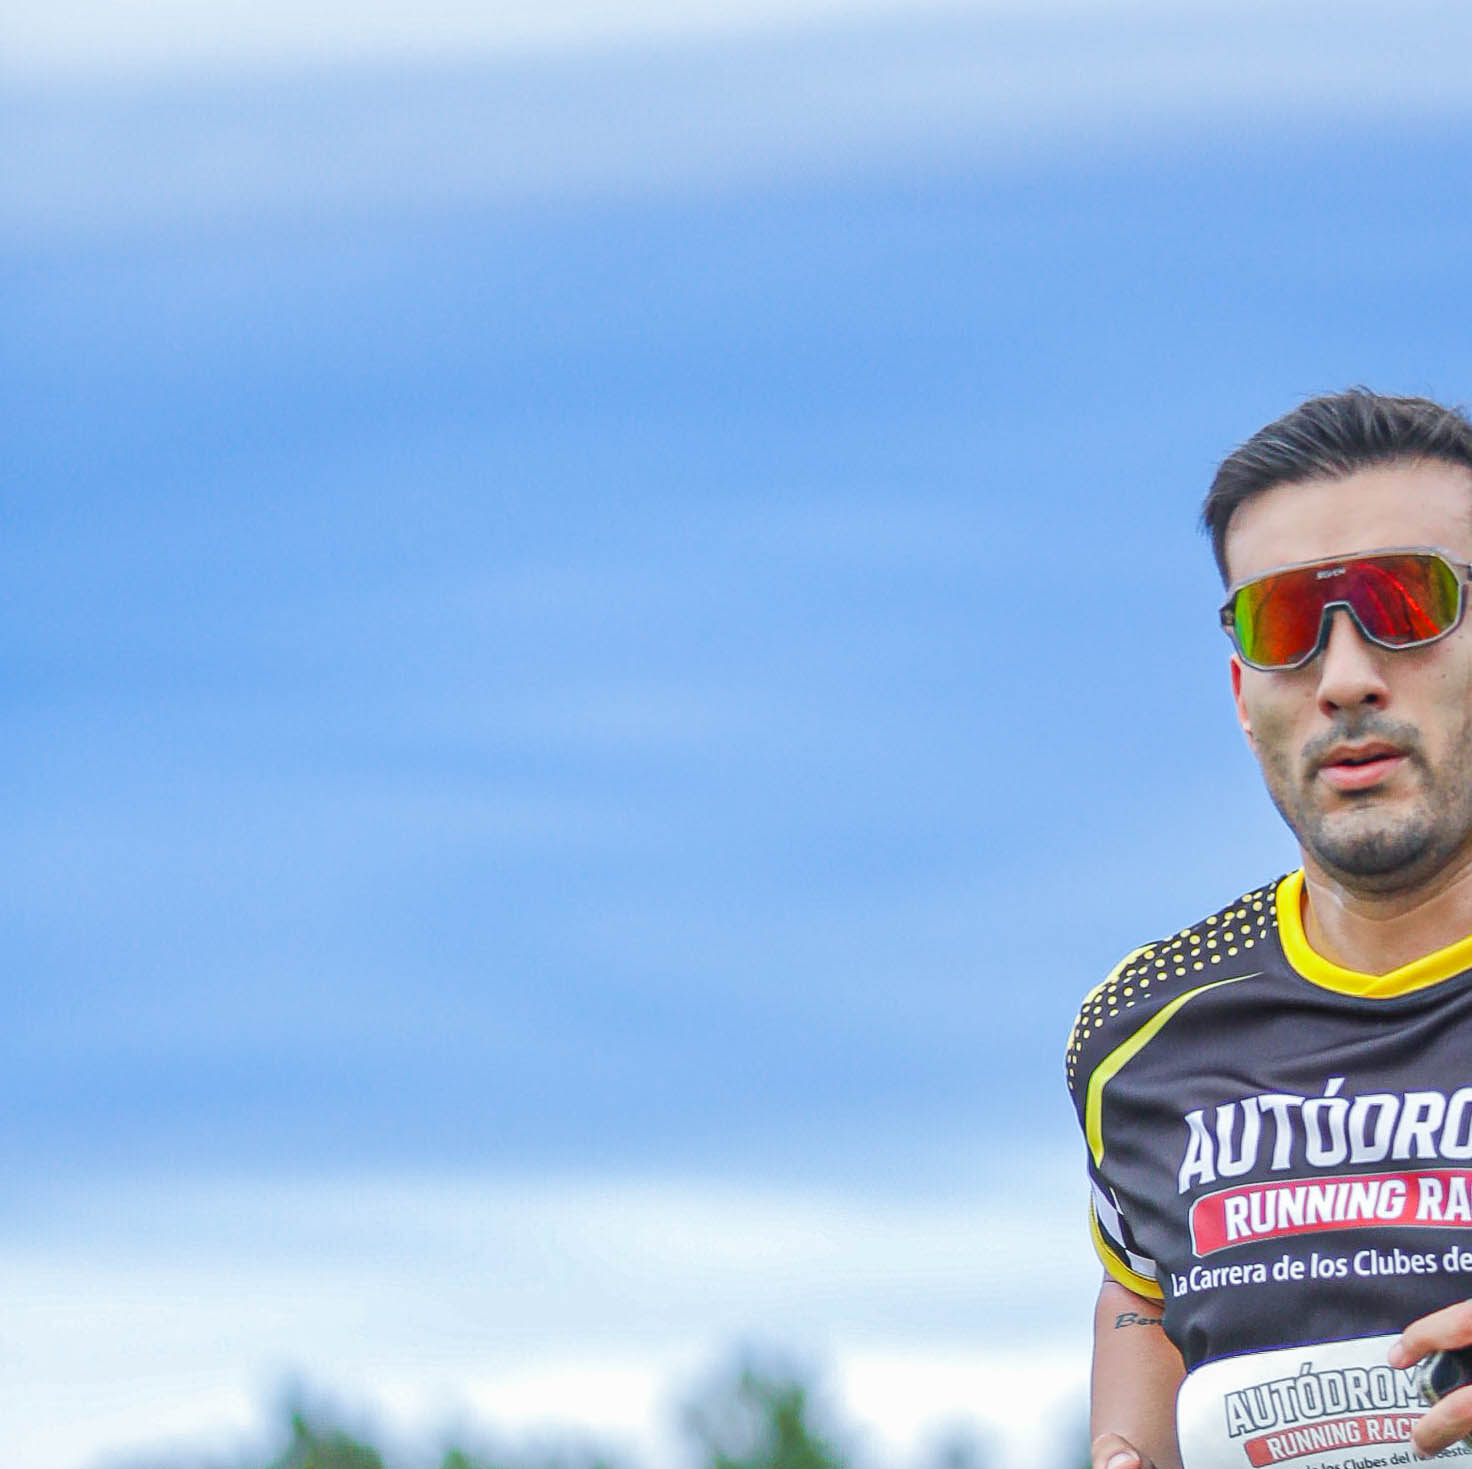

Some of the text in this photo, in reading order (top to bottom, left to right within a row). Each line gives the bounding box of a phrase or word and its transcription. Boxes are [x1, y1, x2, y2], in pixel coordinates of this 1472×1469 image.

[1225, 1179, 1407, 1241] RUNNING
[1189, 1263, 1267, 1292] Carrera
[1272, 1254, 1305, 1281] de
[1310, 1252, 1348, 1279] los
[1353, 1248, 1438, 1276] Clubes
[1224, 1361, 1433, 1439] AUTÓDROM
[1266, 1420, 1360, 1461] RUNNING
[1391, 1451, 1411, 1466] del
